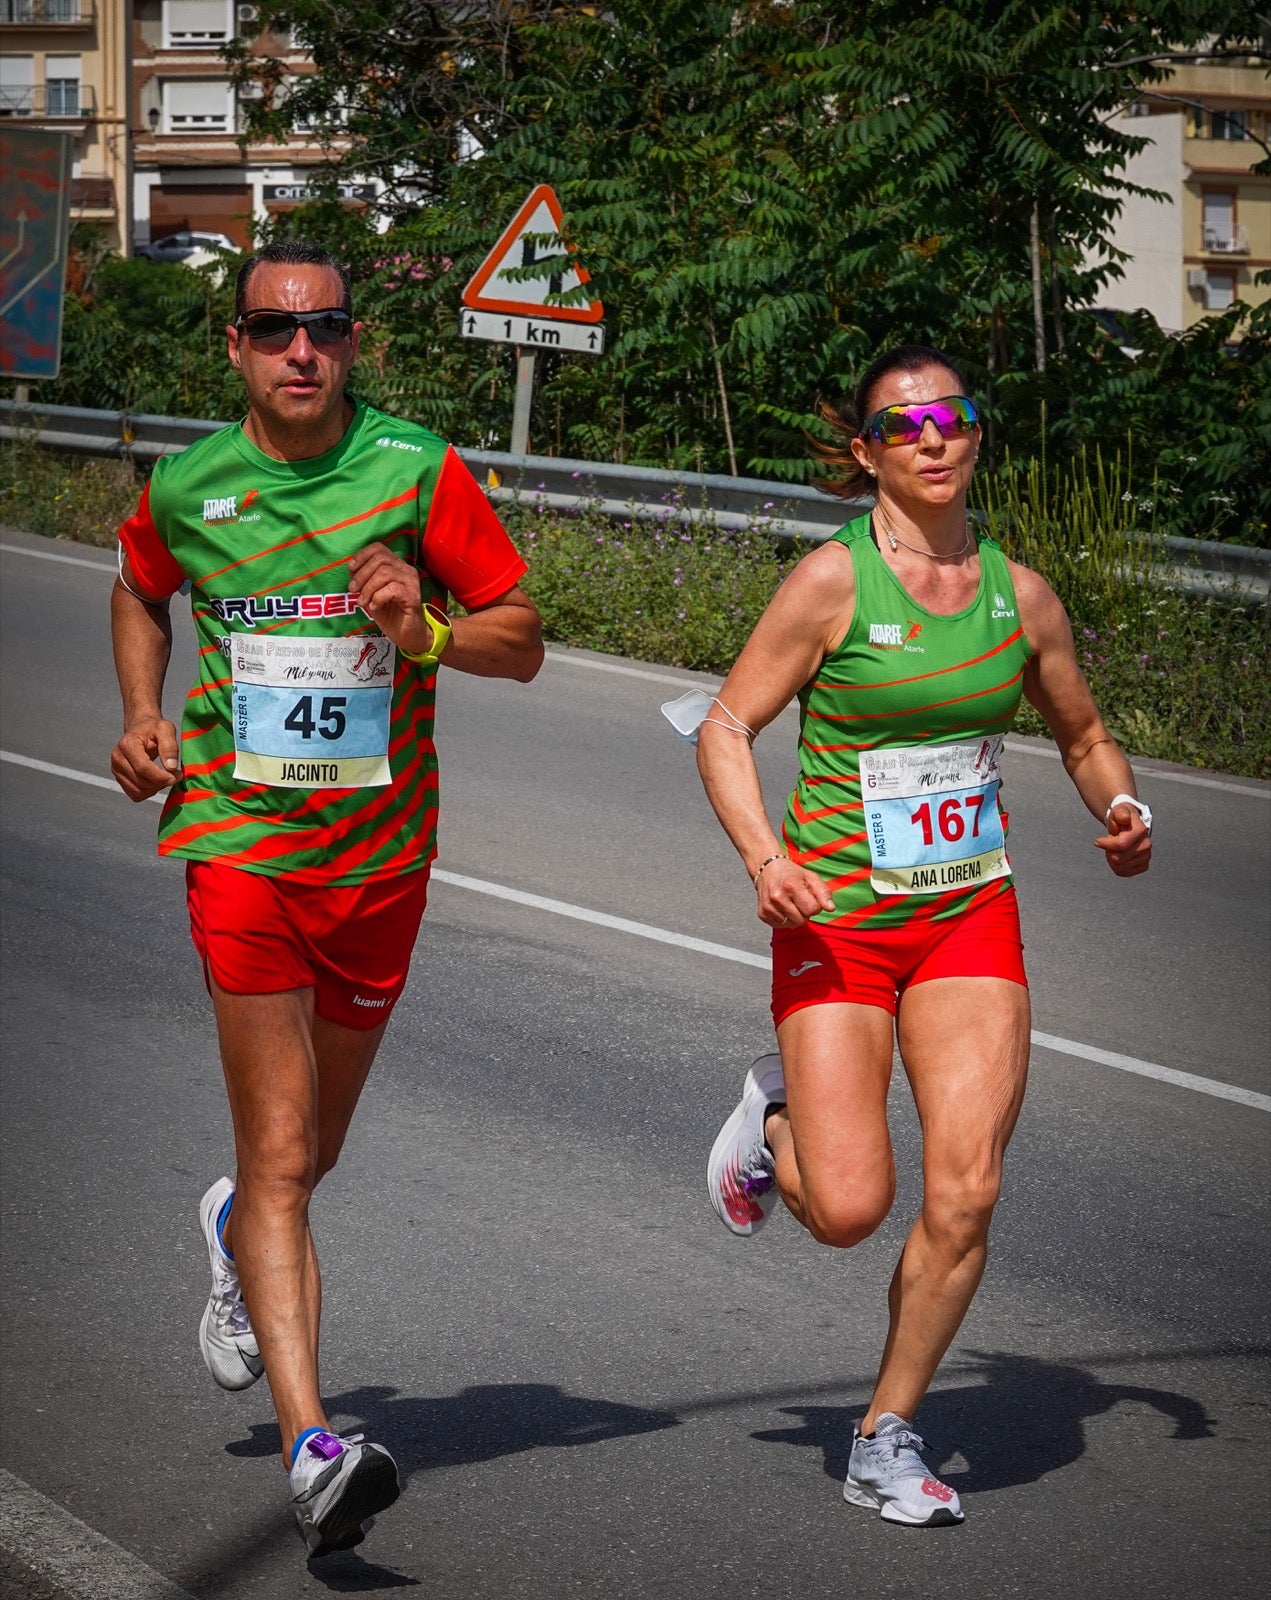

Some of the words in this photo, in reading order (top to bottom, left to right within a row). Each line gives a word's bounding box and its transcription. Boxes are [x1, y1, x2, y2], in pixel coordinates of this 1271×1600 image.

[504, 319, 512, 338] 1
[526, 322, 561, 345] km
[391, 440, 423, 452] Cervi
[203, 496, 238, 521] ATARFE
[238, 513, 261, 524] Atarfe
[991, 608, 1015, 618] Cervi
[869, 623, 903, 645] ATARFE
[238, 703, 248, 740] MASTER
[284, 695, 347, 740] 45
[281, 763, 338, 782] JACINTO
[871, 812, 882, 820] B
[911, 794, 985, 846] 167
[872, 821, 887, 857] MASTER
[911, 869, 938, 888] ANA
[941, 860, 981, 884] LORENA
[352, 994, 386, 1008] luanvi
